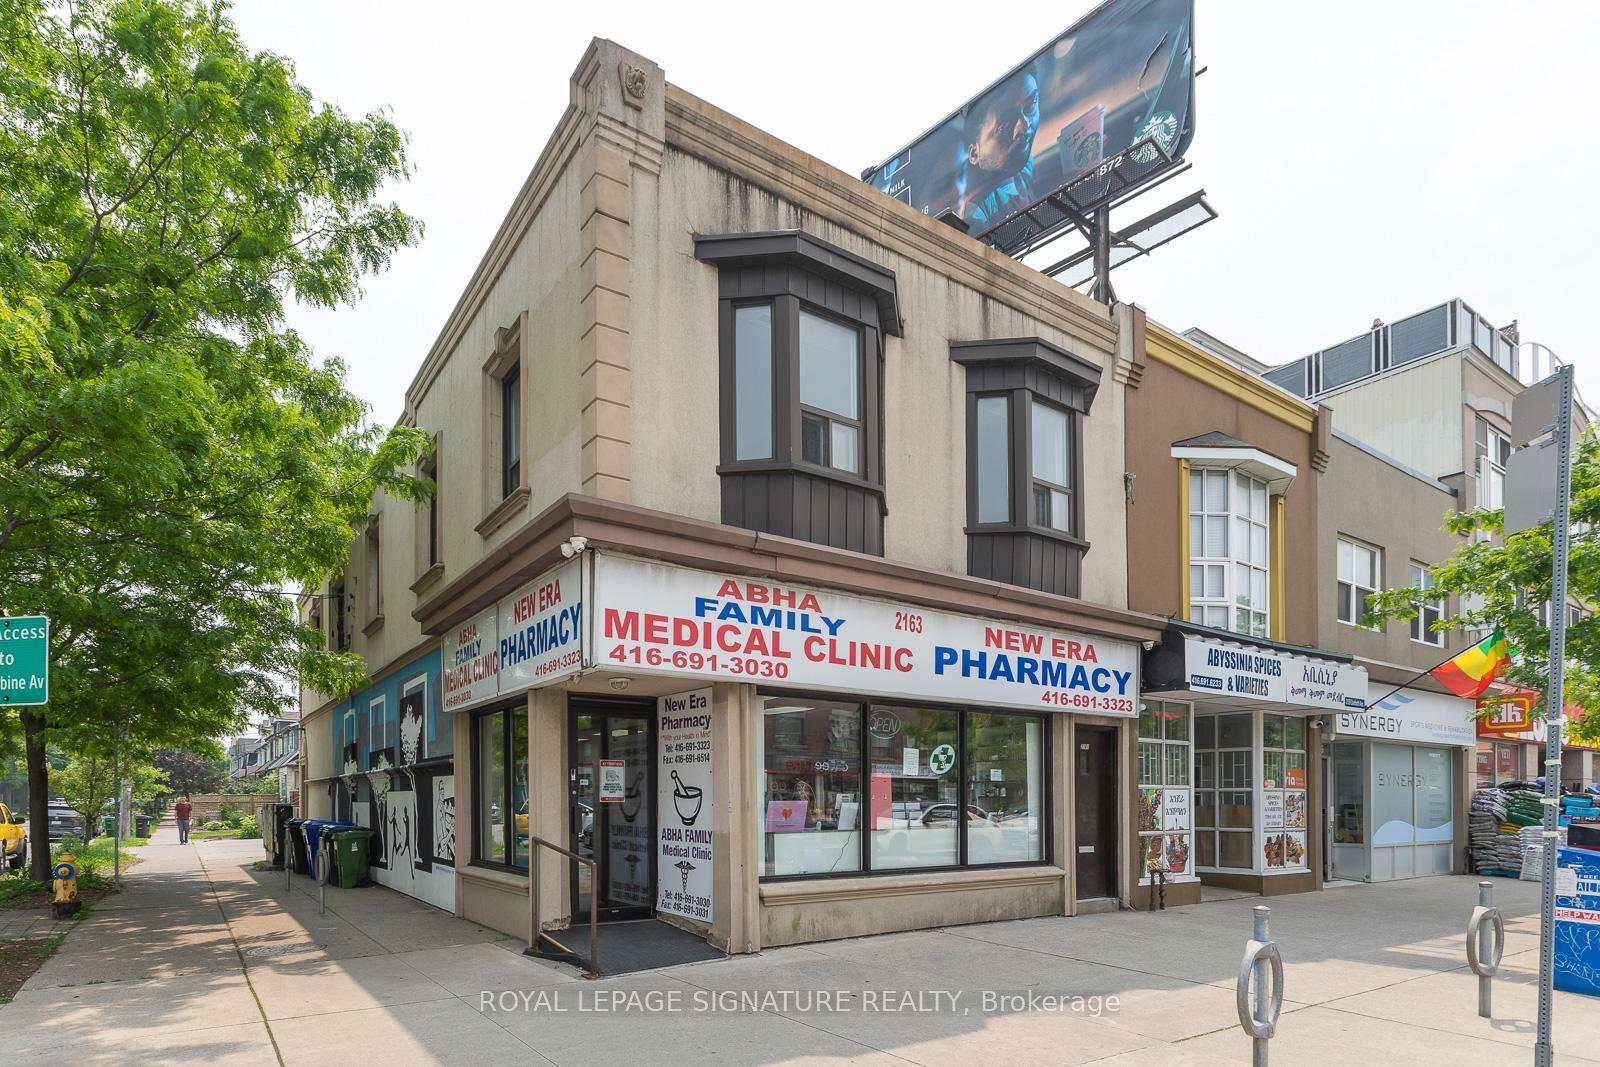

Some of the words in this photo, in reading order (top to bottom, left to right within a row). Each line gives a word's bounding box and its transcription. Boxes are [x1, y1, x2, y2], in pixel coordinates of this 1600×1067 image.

[1099, 155, 1123, 175] 872
[513, 592, 536, 624] NEW
[539, 579, 562, 612] ERA
[716, 578, 823, 614] ABHA
[695, 596, 847, 637] FAMILY
[895, 611, 923, 634] 2163
[458, 623, 477, 646] ABHA
[500, 602, 582, 670] PHARMACY
[604, 607, 792, 659] MEDICAL
[803, 635, 914, 673] CLINIC
[984, 626, 1044, 655] NEW
[1051, 638, 1098, 663] ERA
[455, 638, 482, 666] FAMILY
[608, 644, 789, 679] 416-691-3030
[1207, 647, 1253, 673] ABYSSINIA
[1254, 655, 1281, 677] SPICES
[444, 663, 472, 693] MEDICAL
[473, 650, 498, 682] CLINIC
[535, 650, 581, 677] 416-691-3323
[934, 645, 1132, 696] PHARMACY
[29, 674, 45, 689] Av
[1227, 676, 1233, 692] &
[1234, 674, 1269, 696] VARIETIES
[665, 697, 686, 712] New
[689, 694, 706, 709] Era
[1041, 690, 1133, 712] 416-691-3323
[661, 714, 711, 730] Pharmacy
[870, 717, 897, 731] OPEN
[1341, 712, 1403, 734] SYNERGY
[674, 740, 710, 752] 416-691-3323
[674, 753, 710, 763] 416-691-6514
[661, 828, 683, 842] ABHA
[685, 828, 713, 844] FAMILY
[662, 844, 690, 858] Medical
[691, 846, 712, 861] Clinic
[672, 902, 709, 918] 416-691-3031
[674, 892, 711, 908] 416-691-3030
[1555, 910, 1581, 919] HELP
